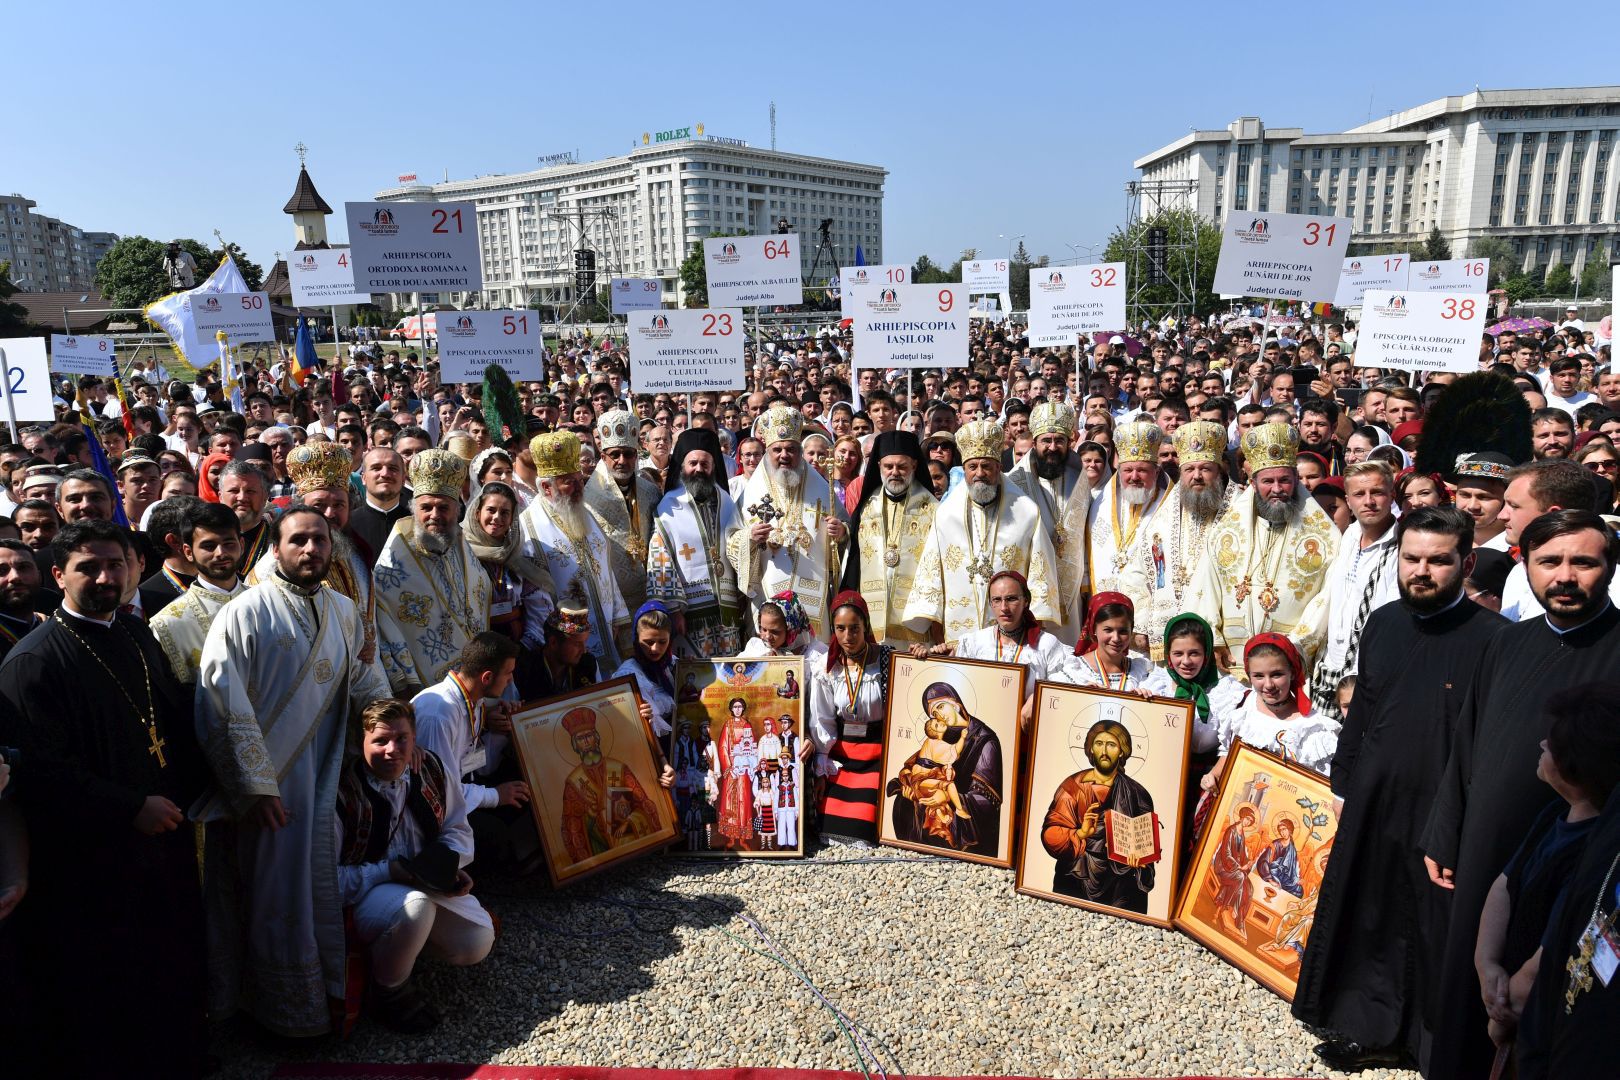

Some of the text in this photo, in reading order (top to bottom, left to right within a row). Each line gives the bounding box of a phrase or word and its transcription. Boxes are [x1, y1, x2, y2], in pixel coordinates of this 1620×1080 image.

[655, 127, 690, 143] ROLEX
[432, 208, 463, 234] 21
[1302, 222, 1336, 247] 31
[764, 239, 790, 260] 64
[382, 252, 452, 260] ARHIEPISCOPIA
[368, 265, 419, 273] ORTODOXA
[421, 265, 459, 273] ROMANA
[994, 261, 1006, 272] 15
[1246, 261, 1313, 272] ARHIEPISCOPIA
[1383, 258, 1403, 272] 17
[1463, 262, 1484, 277] 16
[886, 268, 905, 283] 10
[1091, 268, 1117, 288] 32
[1282, 273, 1294, 281] DE
[1294, 274, 1311, 282] JOS
[369, 278, 469, 287] CELOR DOUA AMERICI
[643, 281, 658, 292] 39
[710, 280, 759, 288] ARHIEPISCOPIA
[1352, 279, 1392, 287] ARHIEPISCOPIA
[241, 296, 263, 310] 50
[938, 289, 953, 313] 9
[1052, 302, 1104, 311] ARHIEPISCOPIA
[1440, 298, 1475, 321] 38
[503, 315, 528, 335] 51
[702, 313, 733, 337] 23
[866, 321, 956, 332] ARHIEPISCOPIA
[1373, 332, 1466, 345] EPISCOPIA SLOBOZIEI
[98, 340, 107, 352] 8
[657, 348, 718, 356] ARHIEPISCOPIA
[638, 359, 676, 367] VADULUI,
[677, 358, 727, 366] FELEACULUI
[668, 368, 708, 376] CLUJULUI
